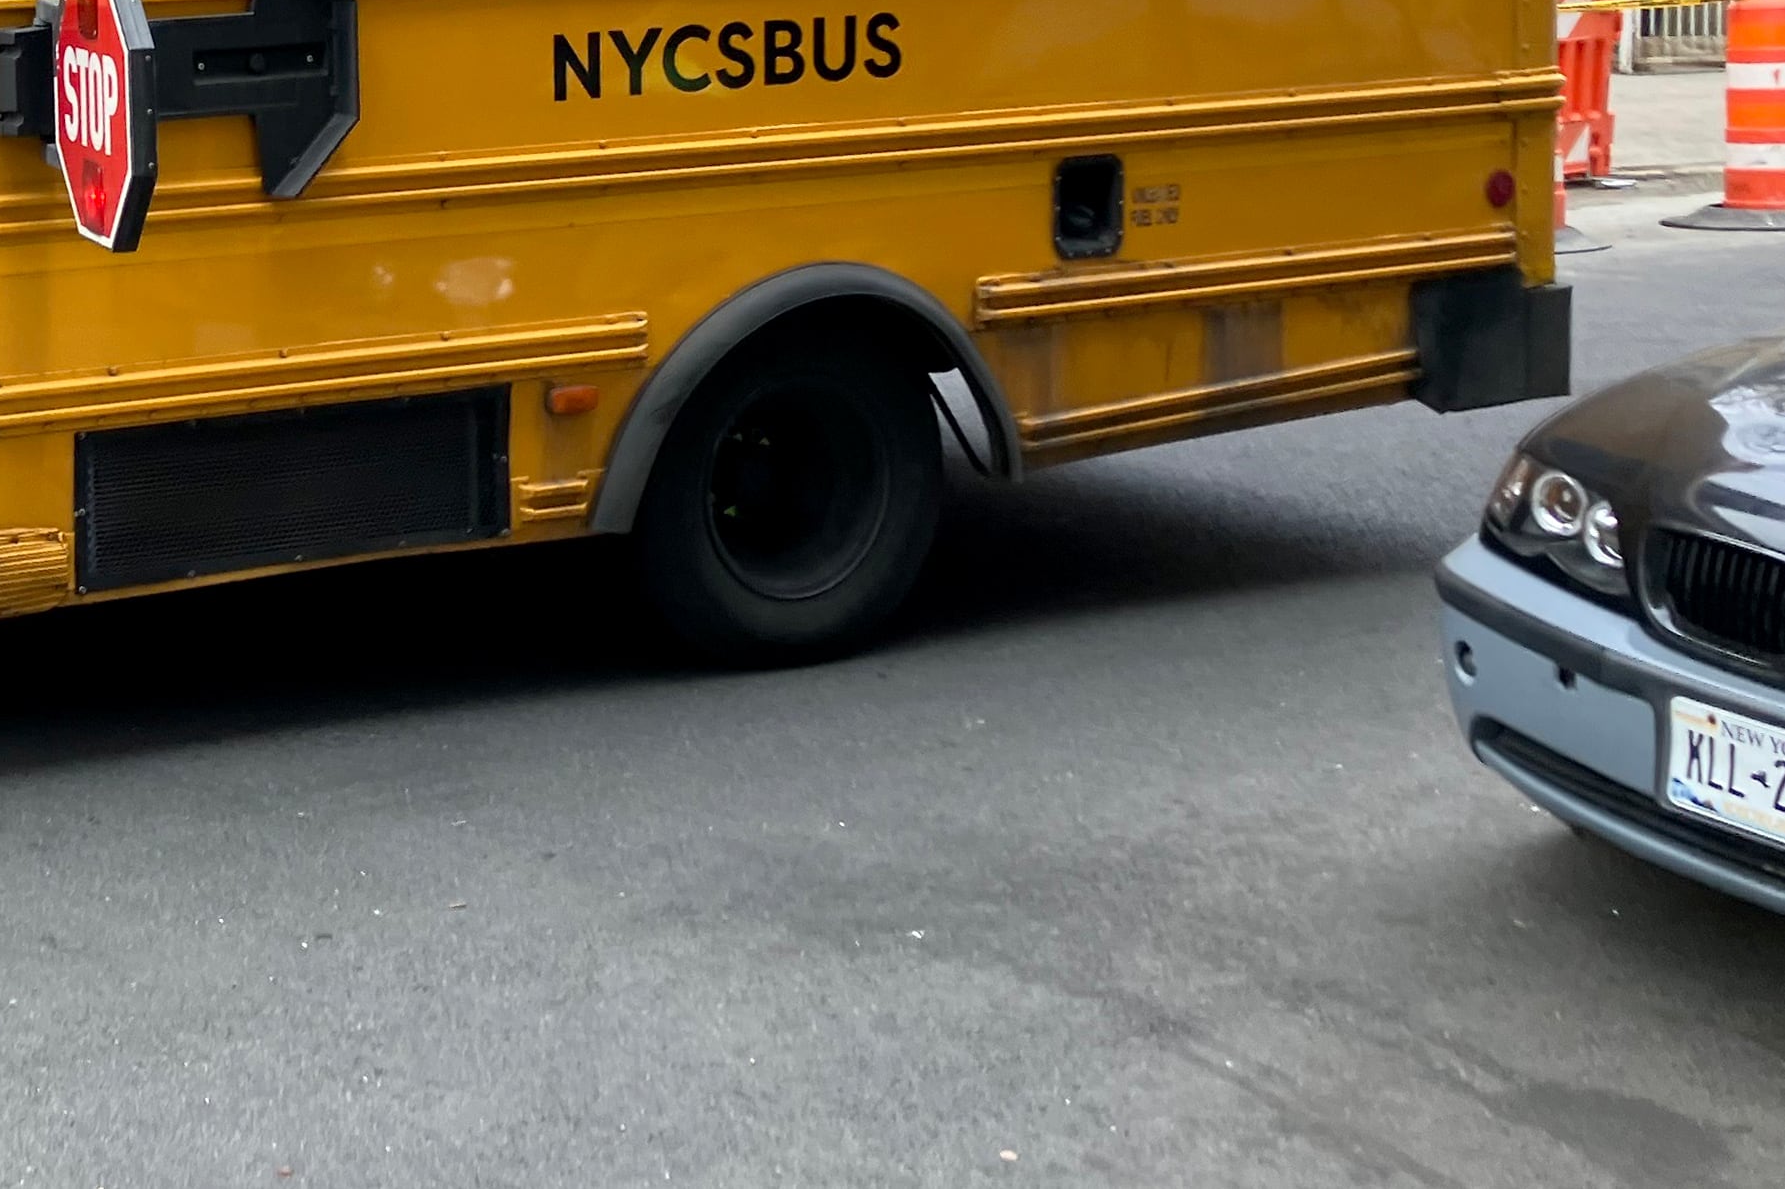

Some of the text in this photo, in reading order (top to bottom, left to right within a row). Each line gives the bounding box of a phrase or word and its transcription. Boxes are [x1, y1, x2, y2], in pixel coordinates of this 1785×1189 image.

[63, 45, 118, 156] STOP
[553, 12, 902, 102] NYCSBUS
[1721, 720, 1764, 747] NEW
